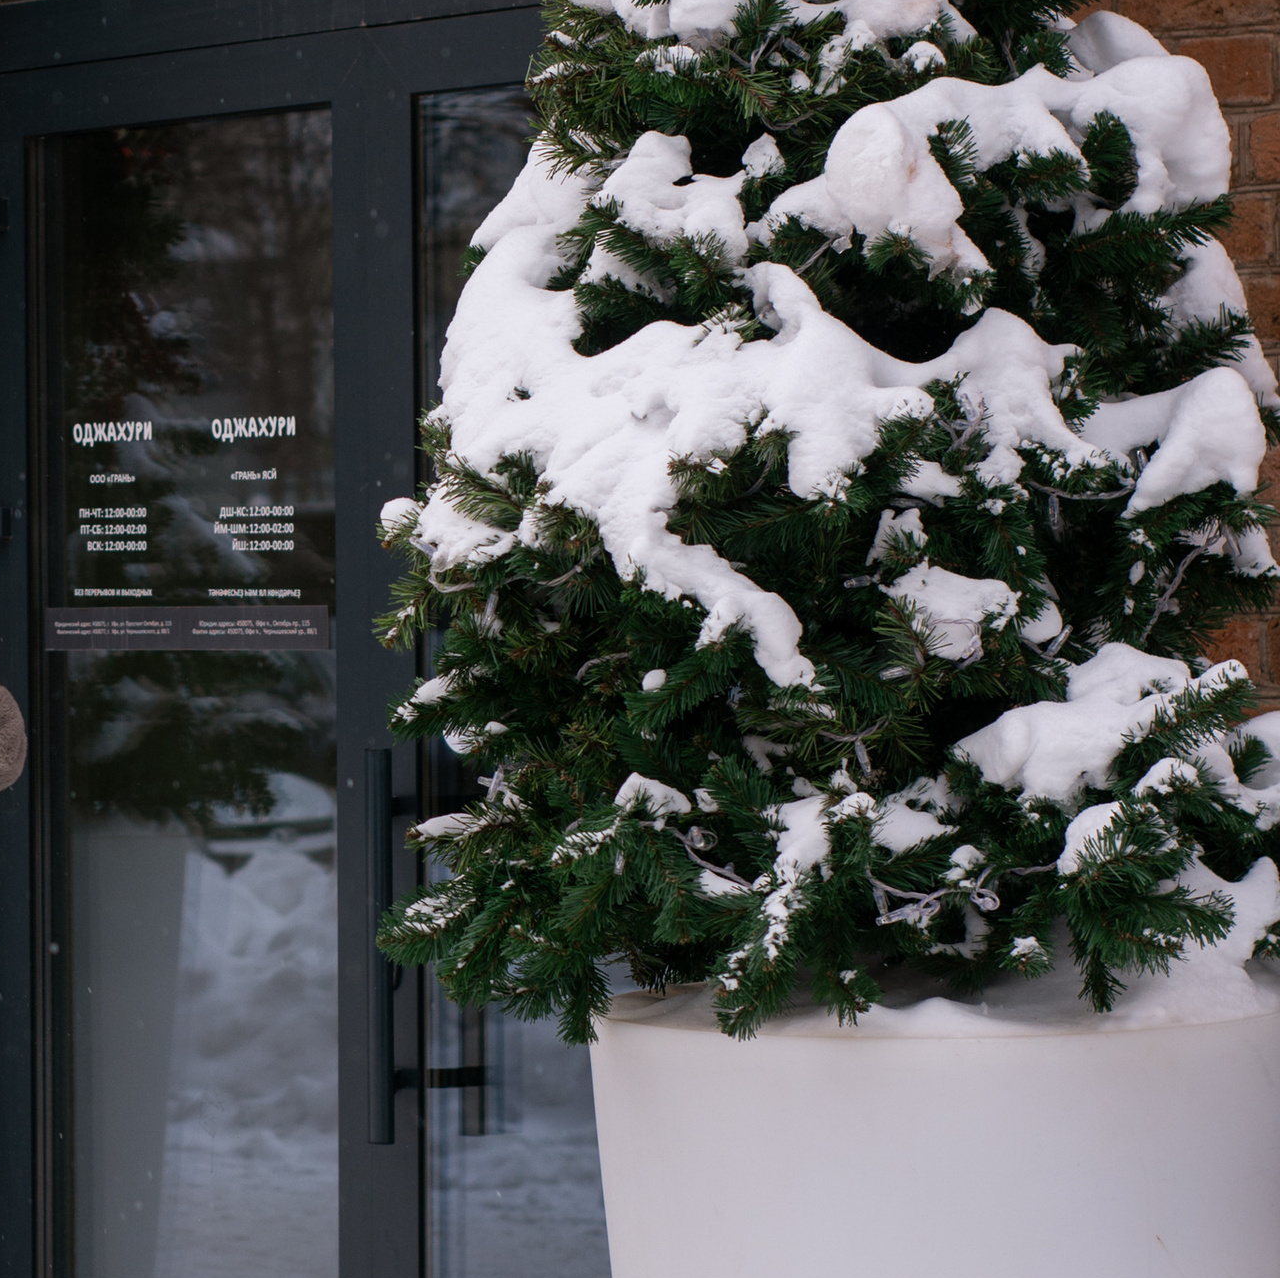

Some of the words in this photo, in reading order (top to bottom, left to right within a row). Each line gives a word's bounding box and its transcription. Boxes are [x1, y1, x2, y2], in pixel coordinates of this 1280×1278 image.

[73, 421, 153, 447] ОДЖАХУРИ
[211, 415, 297, 443] ОДЖАХУРИ
[89, 474, 106, 484] ООО
[104, 507, 147, 518] 12:00-00:00
[249, 505, 295, 517] 12:00-00:00
[104, 524, 147, 535] 12:00-02:00
[249, 523, 295, 534] 12:00-02:00
[104, 540, 147, 551] 12:00-00:00
[249, 540, 295, 551] 12:00-00:00
